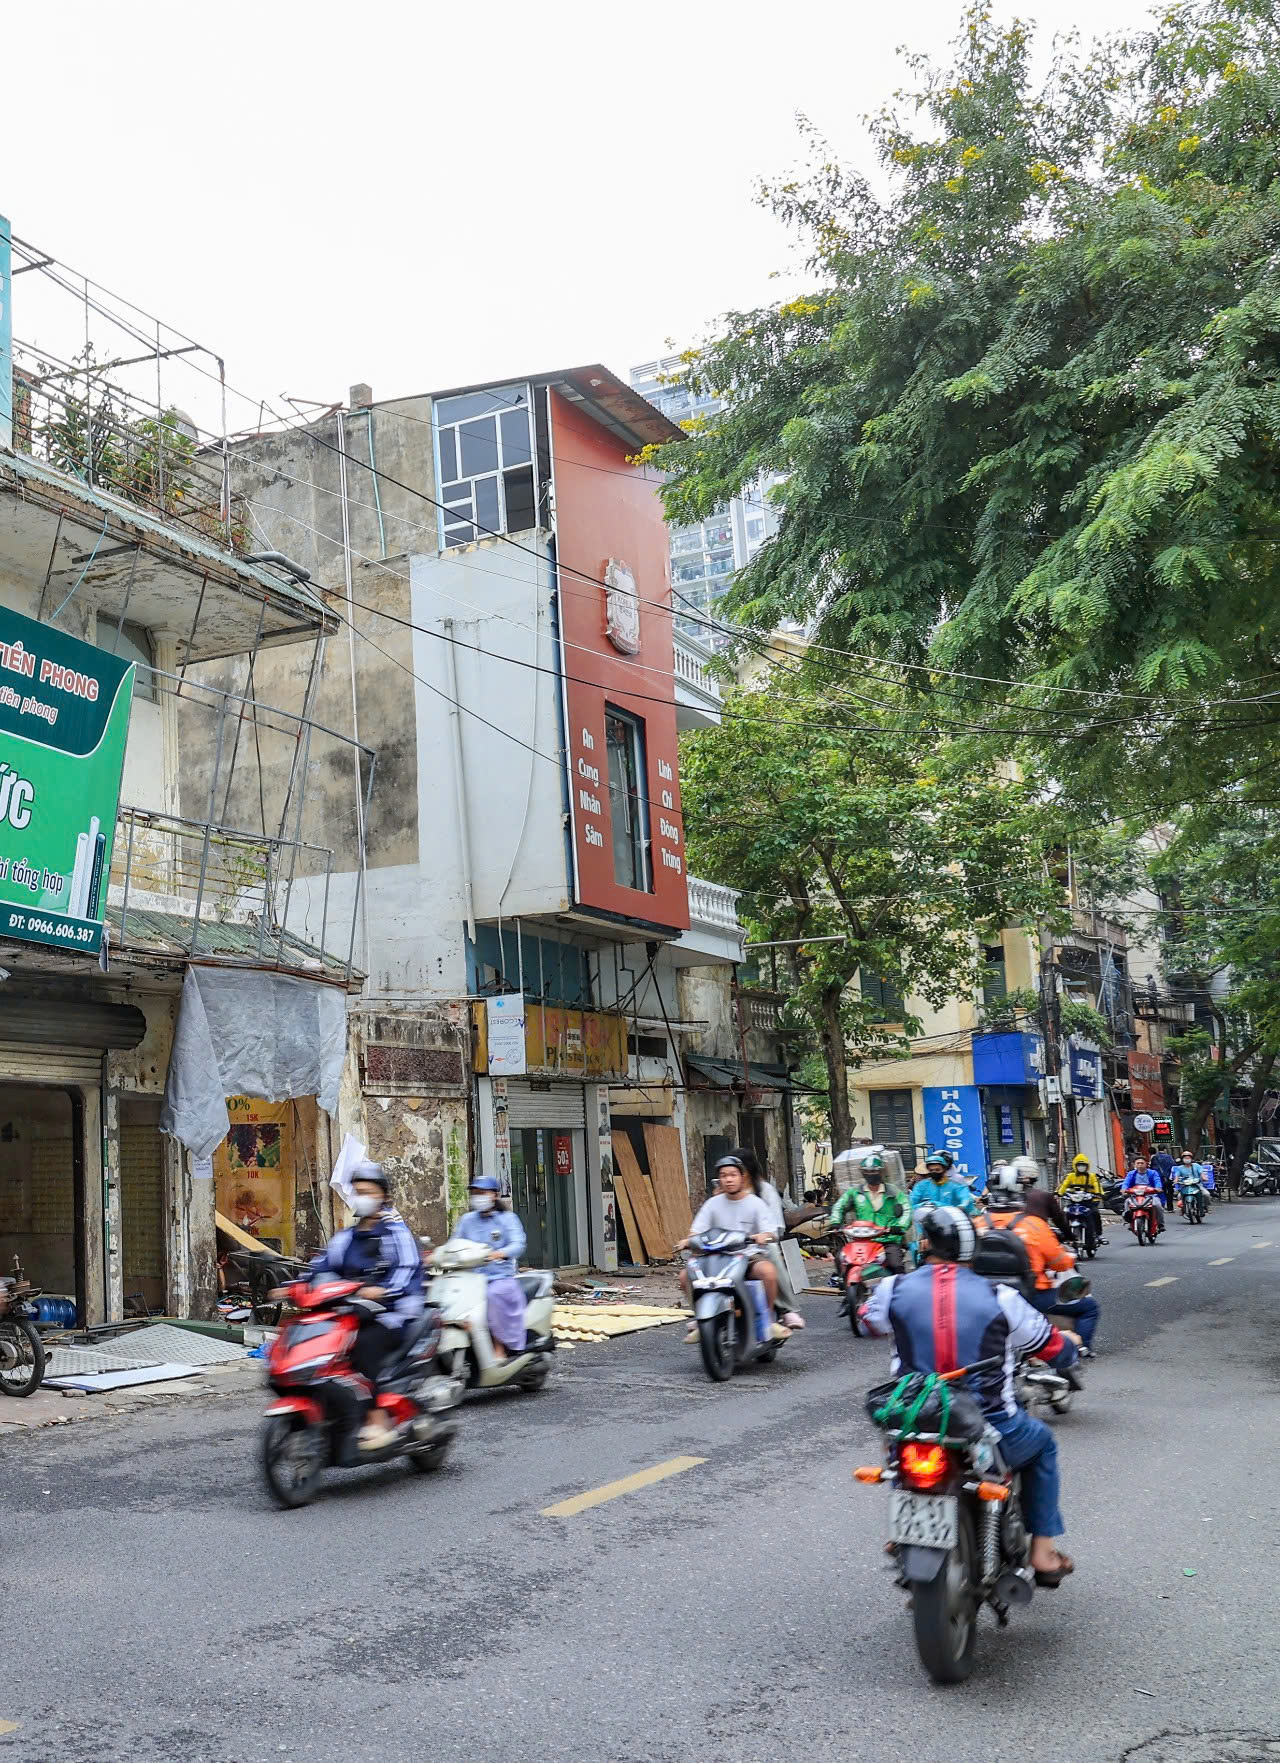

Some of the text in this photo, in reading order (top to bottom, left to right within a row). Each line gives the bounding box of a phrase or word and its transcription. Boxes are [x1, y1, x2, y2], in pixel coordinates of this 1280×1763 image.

[39, 659, 99, 702] PHONG
[20, 696, 58, 725] phong
[582, 727, 594, 750] An
[578, 757, 599, 788] Cung
[658, 758, 673, 781] Linh
[579, 789, 602, 816] Nhân
[585, 822, 603, 848] Sâm
[660, 817, 679, 845] Đông
[661, 847, 682, 875] Trùng
[12, 858, 41, 891] tổng
[42, 867, 64, 896] hợp
[8, 912, 95, 944] ĐT: 0966.606.387
[247, 1170, 259, 1179] 10K
